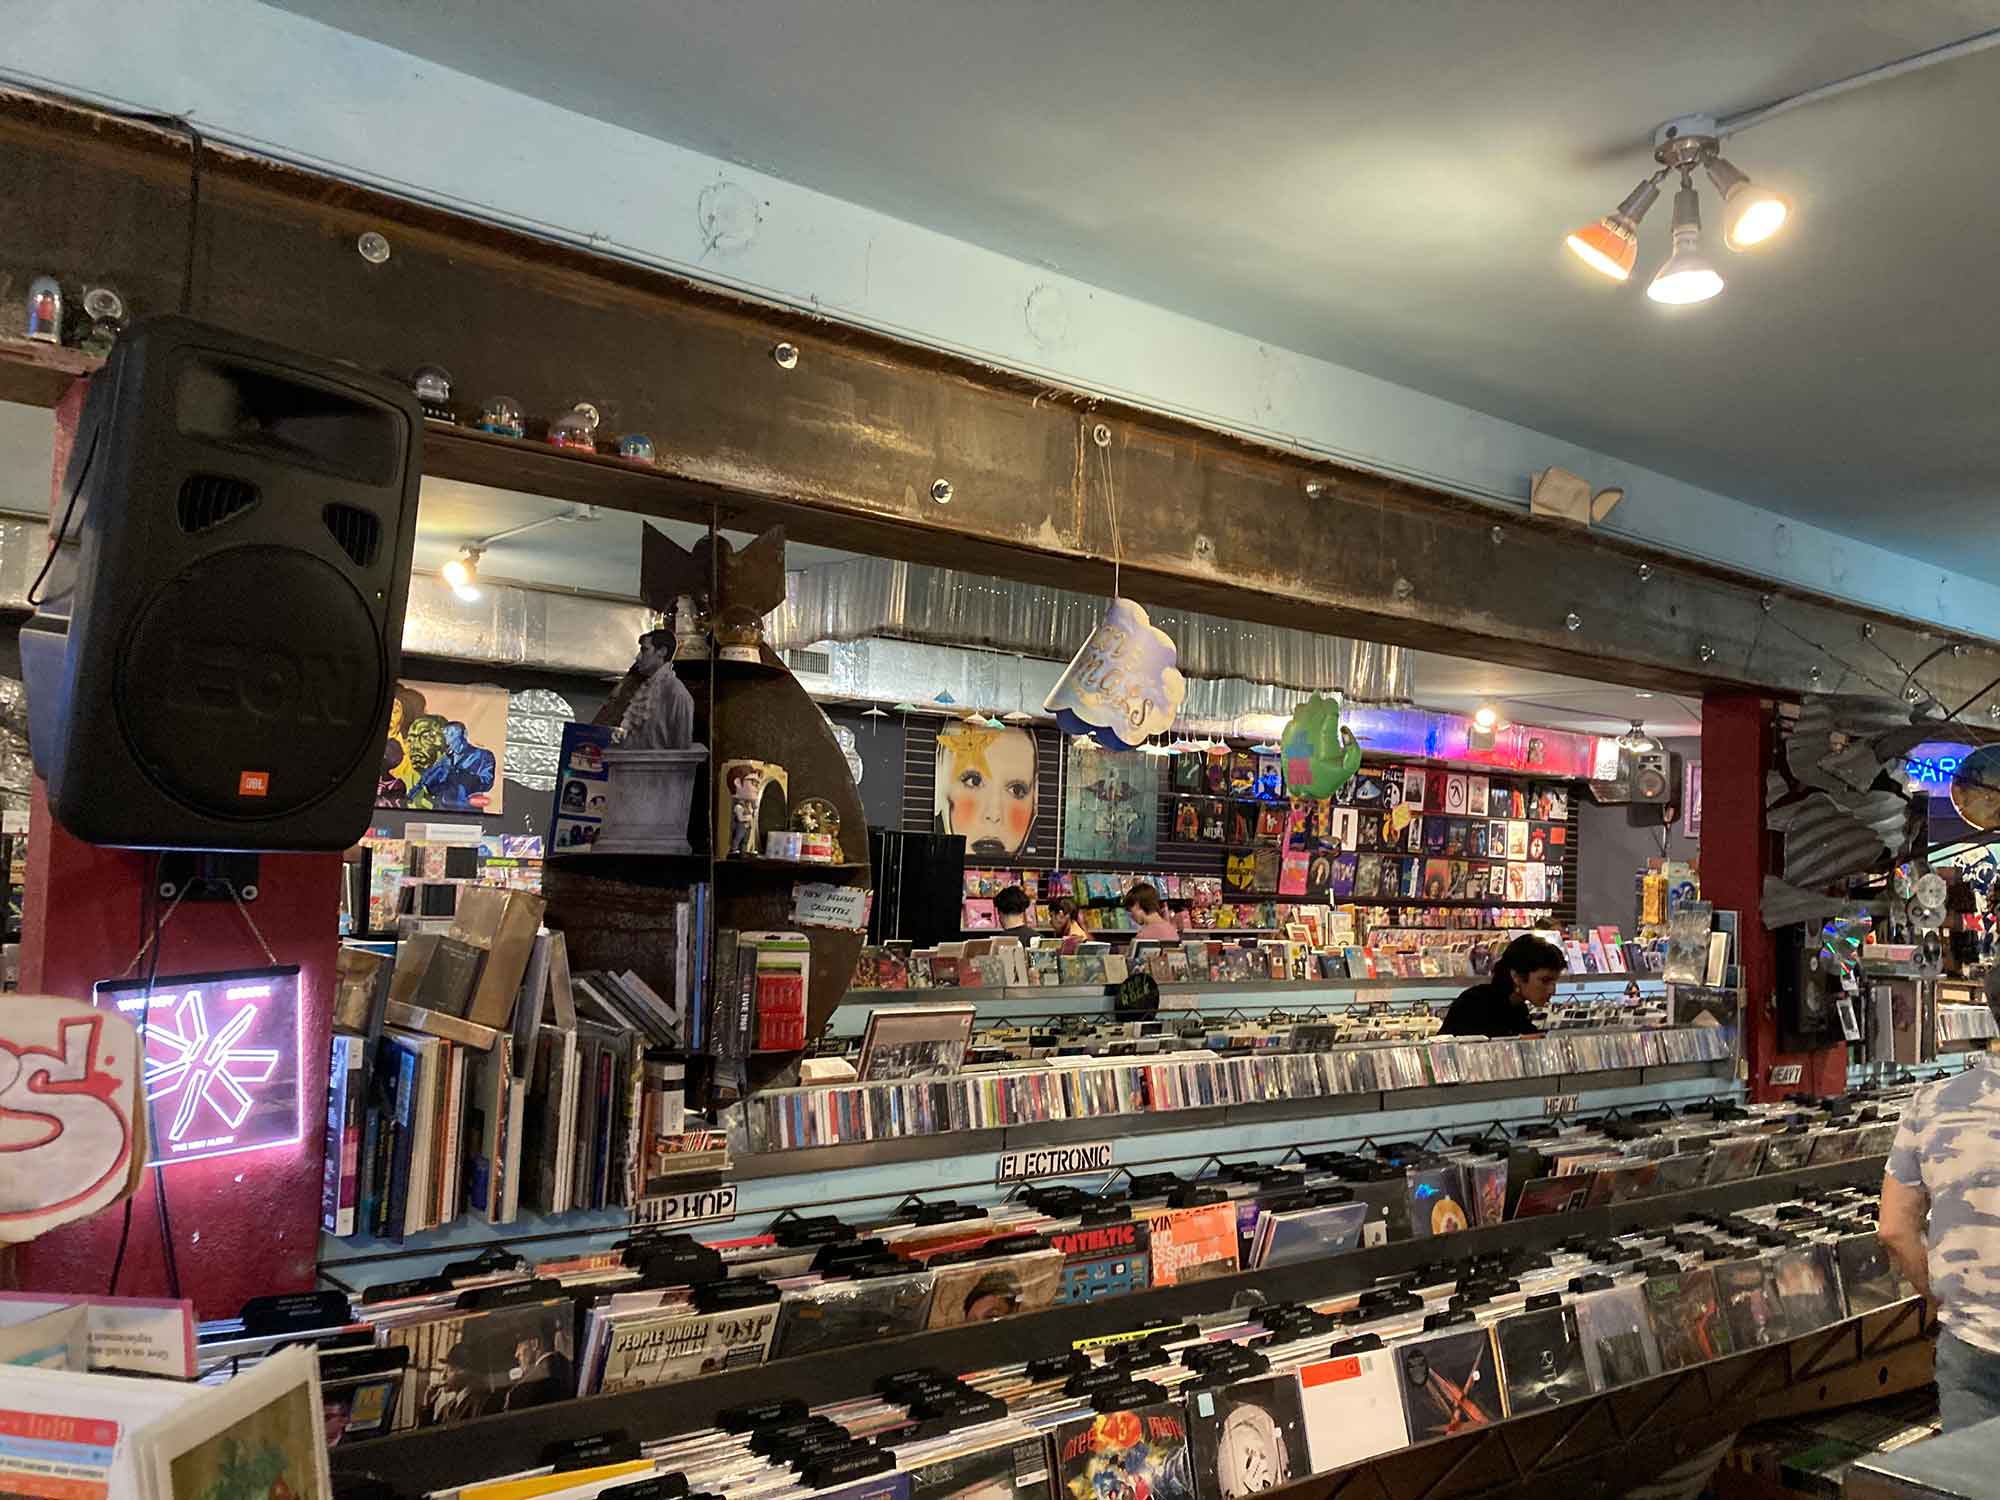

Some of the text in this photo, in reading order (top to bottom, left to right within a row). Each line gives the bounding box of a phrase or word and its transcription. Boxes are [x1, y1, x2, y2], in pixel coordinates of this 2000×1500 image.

[245, 777, 265, 790] JBL
[1001, 1145, 1111, 1180] ELECTRONIC
[636, 1191, 733, 1224] HIP HOP
[617, 1323, 708, 1352] PEOPLE UNDER
[635, 1346, 657, 1366] THE
